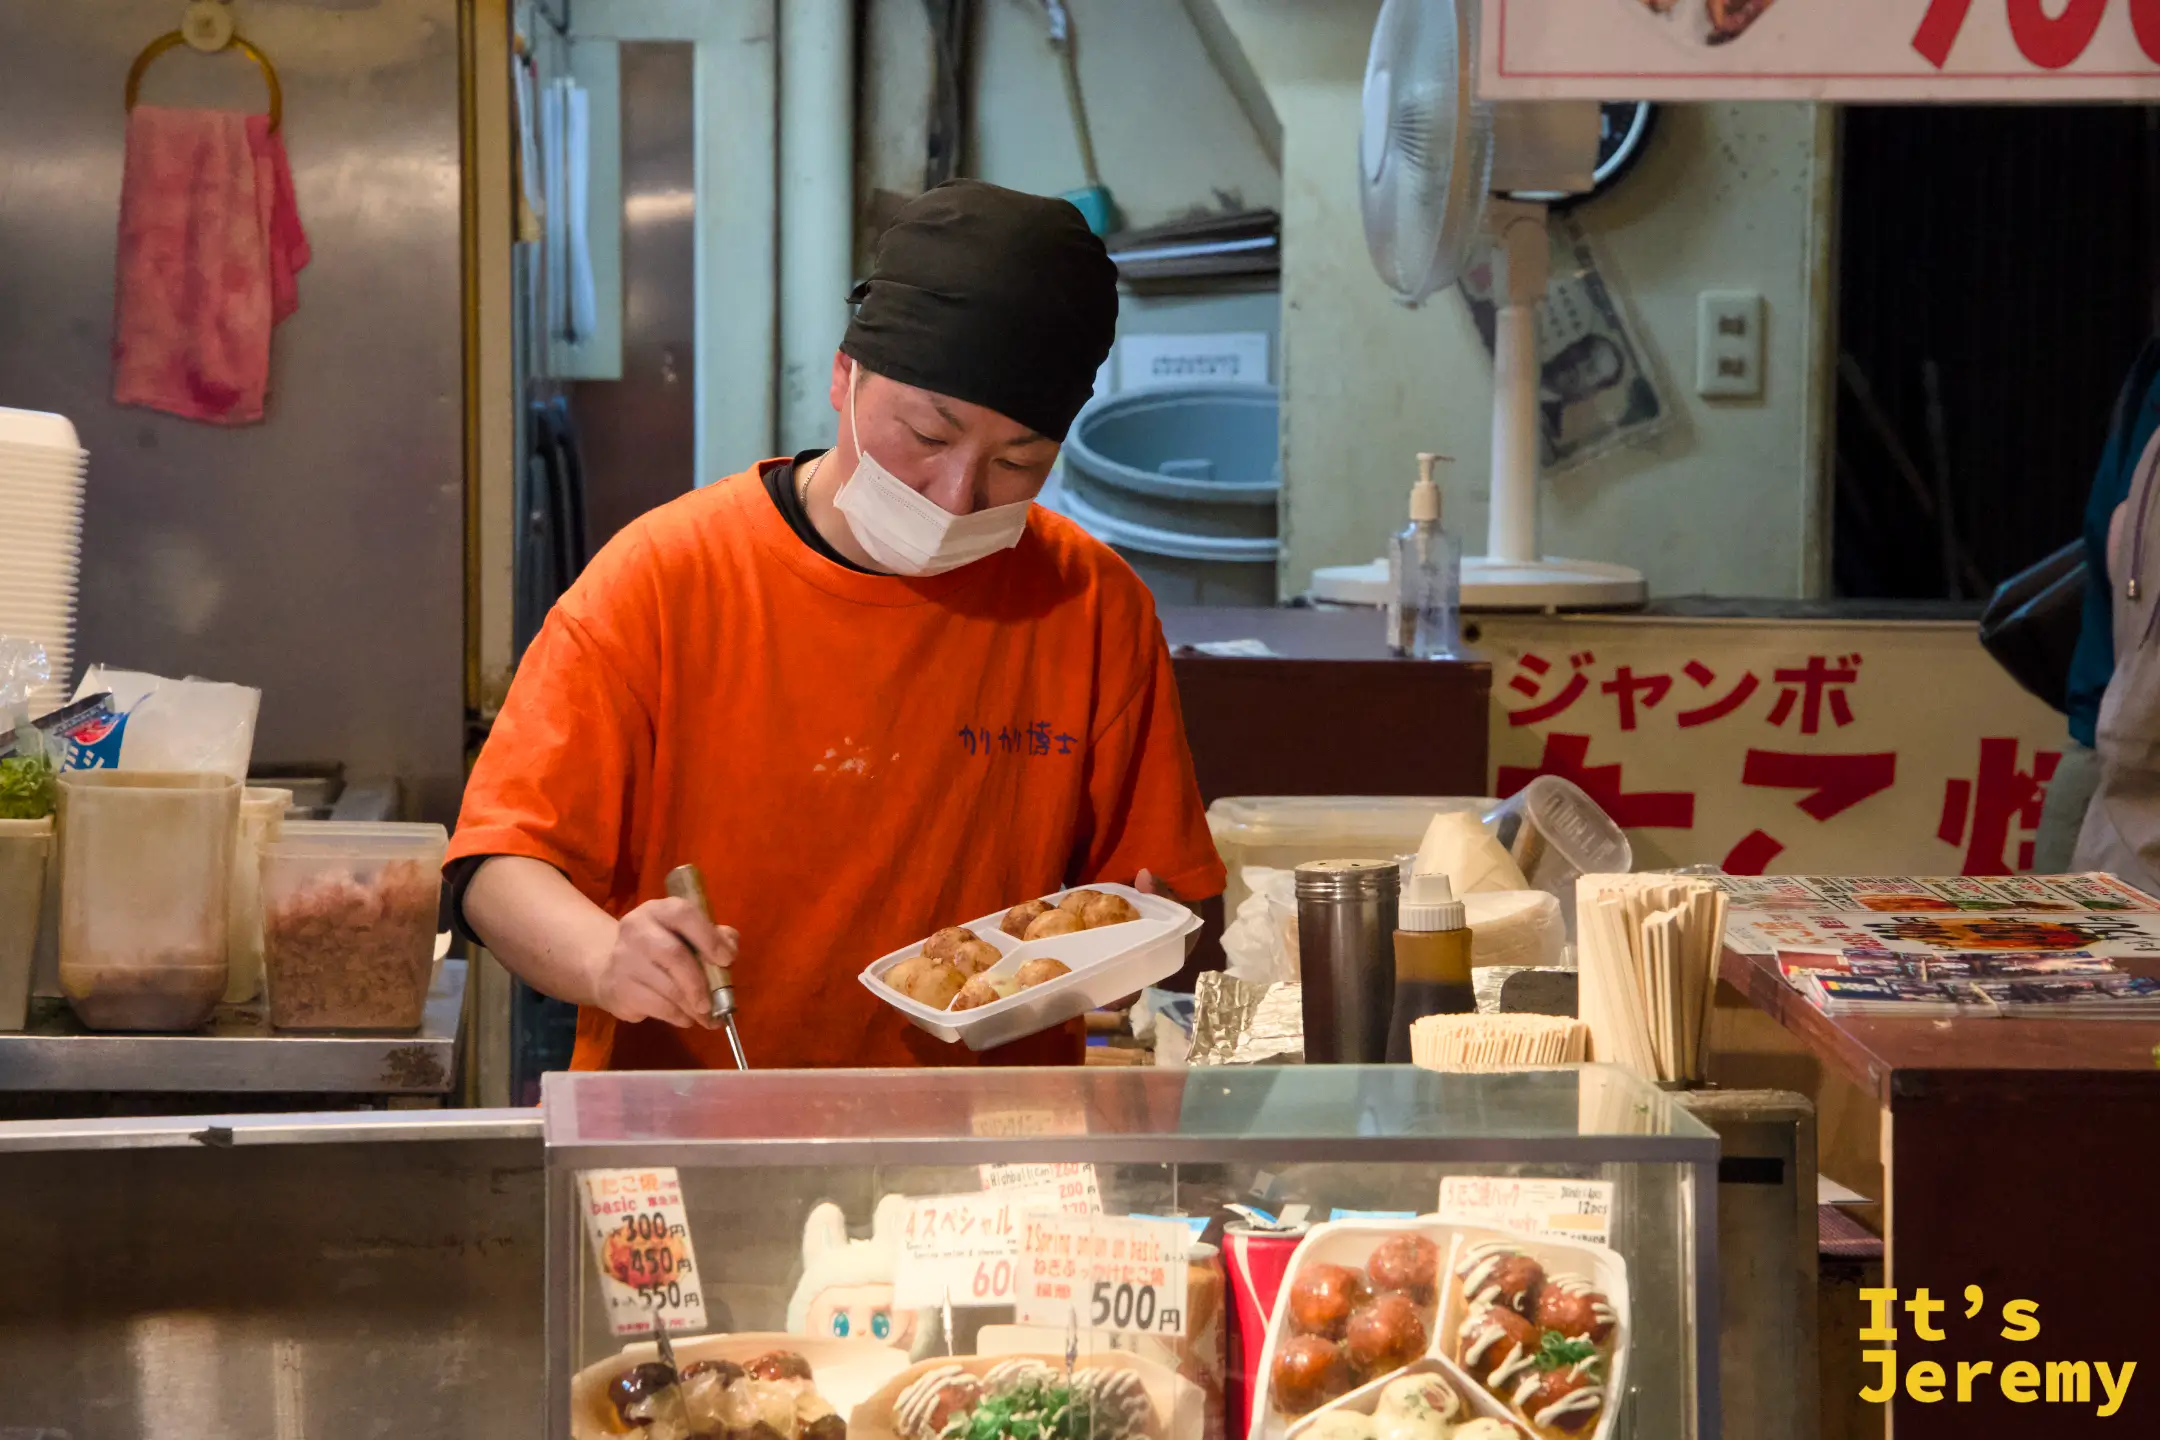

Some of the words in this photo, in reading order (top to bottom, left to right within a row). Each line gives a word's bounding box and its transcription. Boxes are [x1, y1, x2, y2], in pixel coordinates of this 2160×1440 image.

[1508, 651, 1861, 734] ジャンボ
[591, 1196, 638, 1216] basic
[972, 1259, 1018, 1298] 60
[1091, 1281, 1181, 1333] 500円
